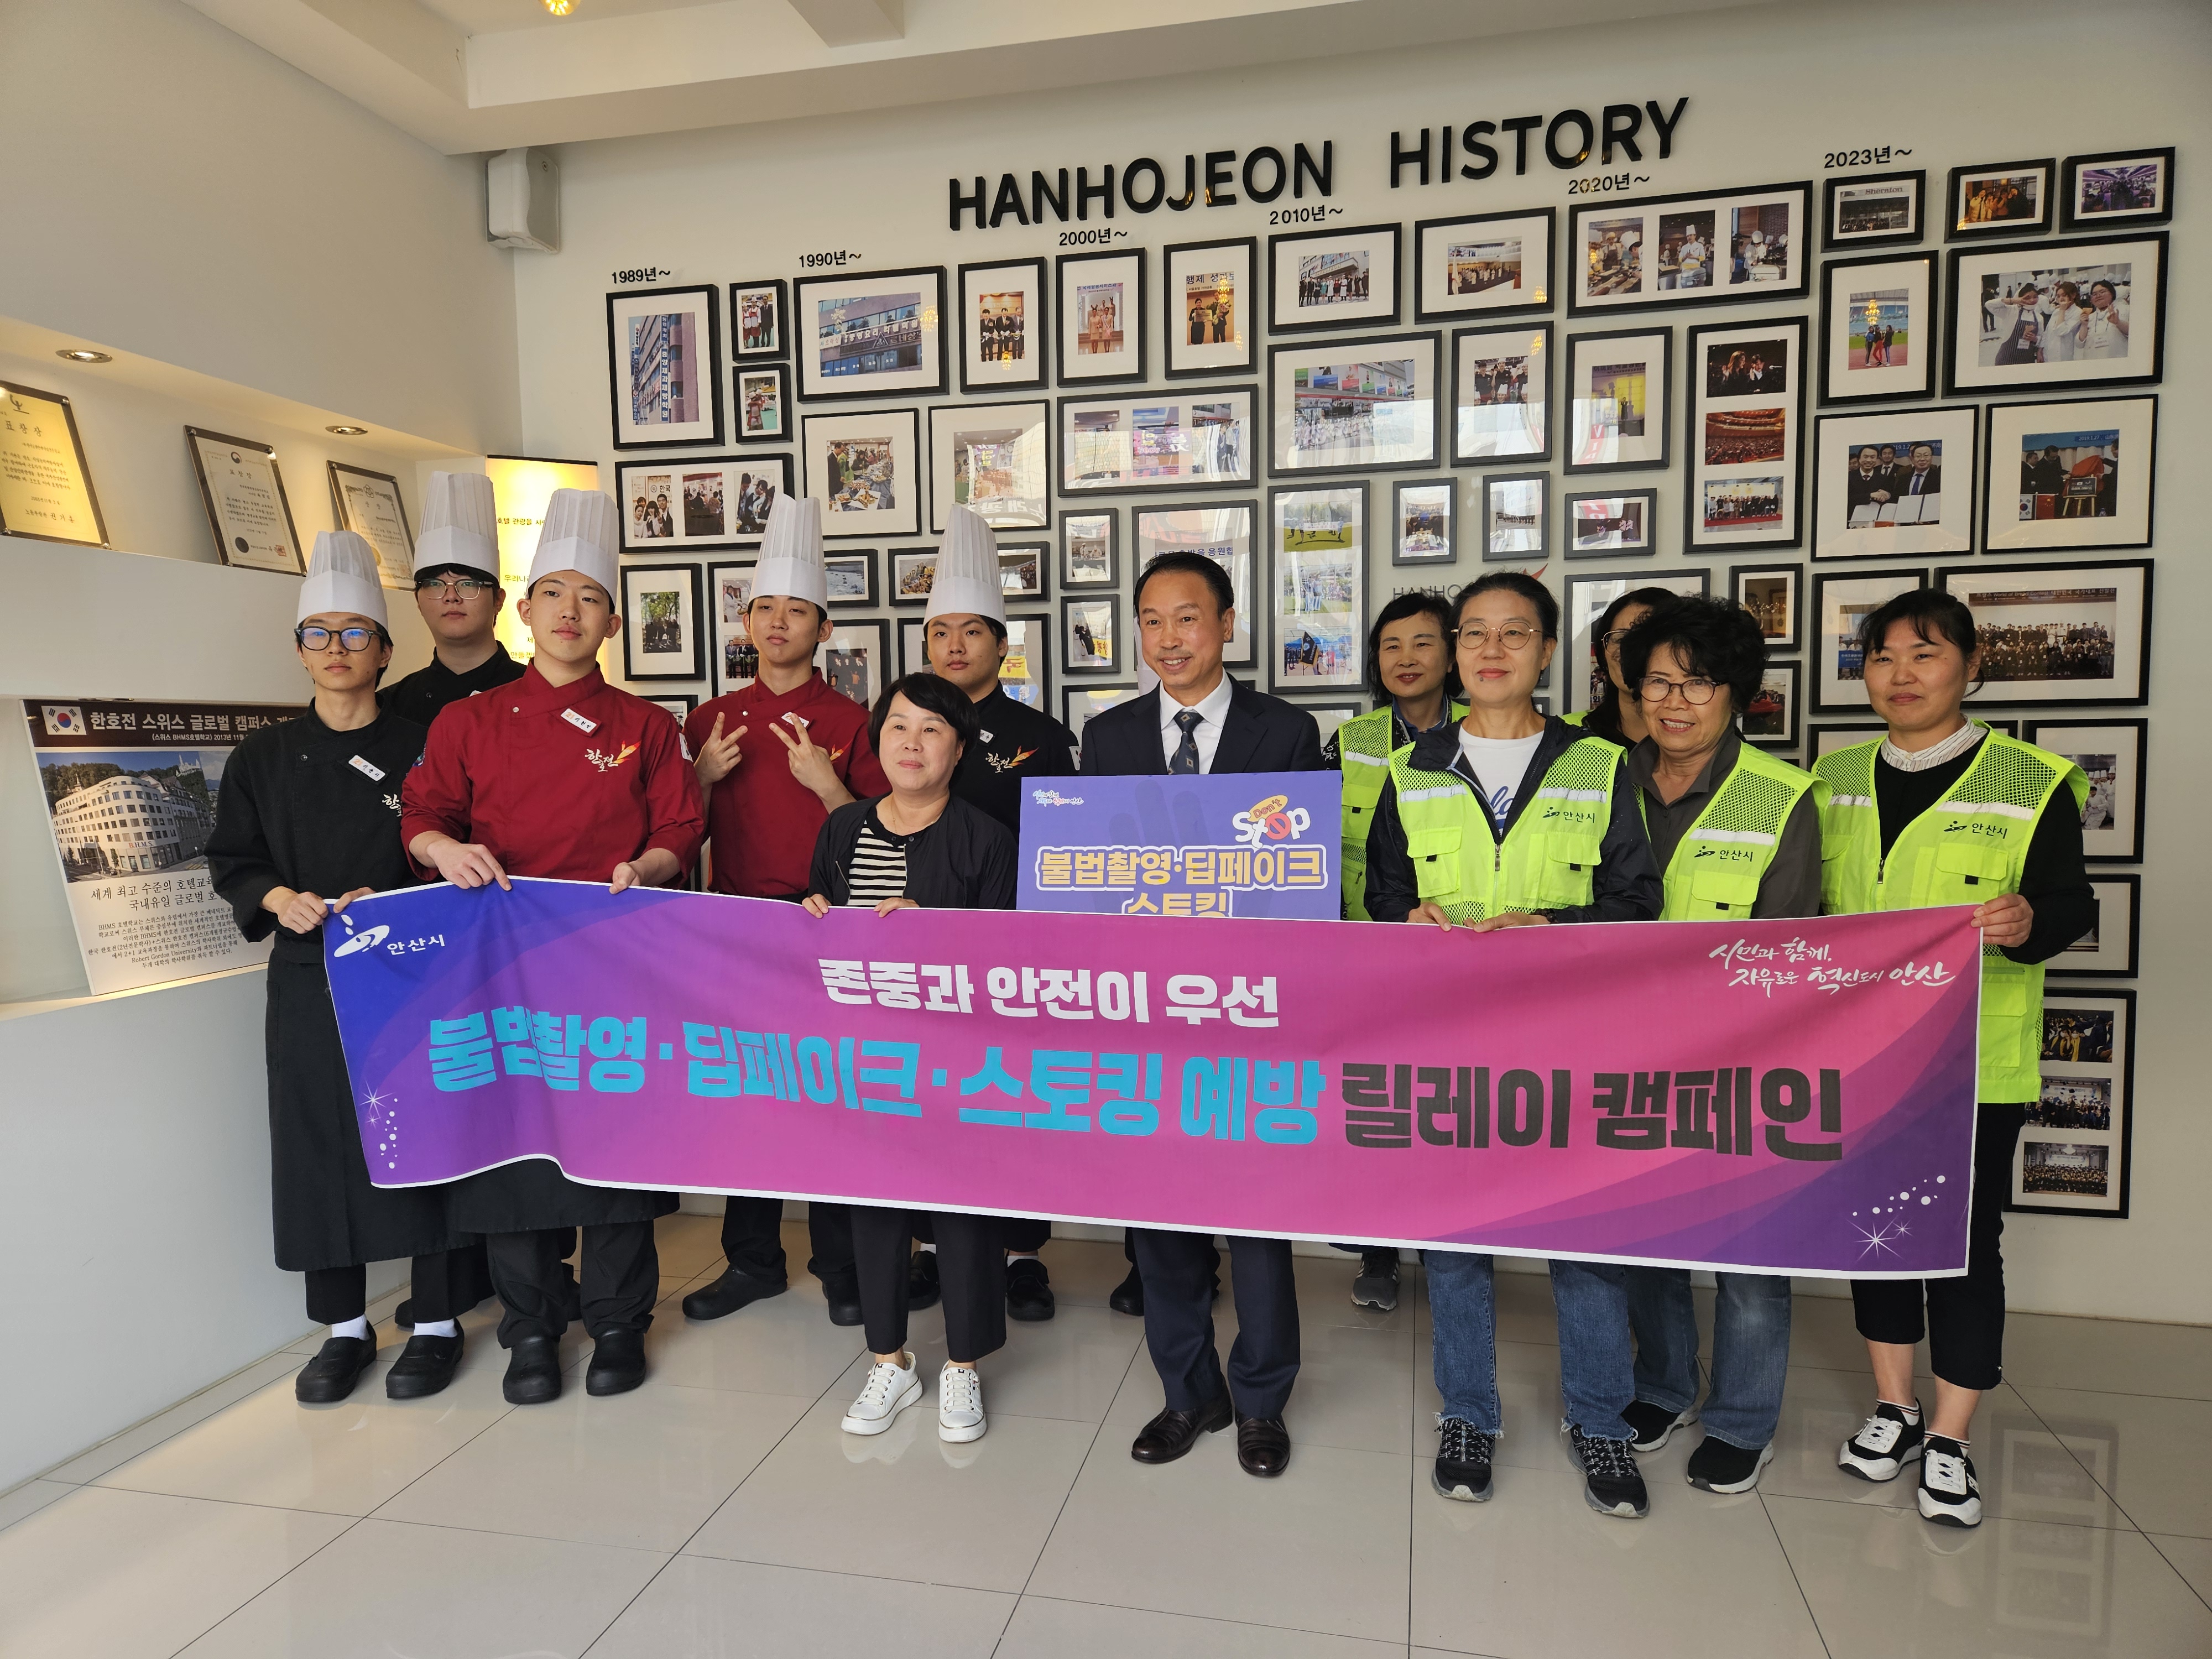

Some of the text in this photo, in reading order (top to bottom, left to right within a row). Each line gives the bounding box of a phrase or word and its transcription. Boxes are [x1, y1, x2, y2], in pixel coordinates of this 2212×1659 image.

[949, 96, 1691, 231] HANHOJEON HISTORY
[1824, 145, 1912, 169] 2023년~
[1568, 173, 1650, 195] 2020년~
[1865, 185, 1903, 195] Sheraton
[1270, 206, 1343, 225] 2010년~
[1059, 227, 1128, 246] 2000년~
[799, 250, 862, 268] 1990년~
[611, 267, 671, 284] 1989년~
[659, 484, 671, 493] 한국
[90, 711, 137, 731] 한호전
[142, 713, 185, 731] 스위스
[190, 714, 231, 732] 글로벌
[173, 733, 212, 742] BHMS호텔학교)
[1253, 797, 1282, 819] Don't
[1563, 811, 1595, 823] 안산시
[1971, 823, 2007, 839] 안산시
[1720, 849, 1754, 862] 안산시
[91, 887, 112, 901] 세계
[117, 885, 138, 898] 최고
[142, 880, 172, 895] 수준의
[129, 896, 171, 911] 국내유일
[175, 891, 204, 906] 글로벌
[140, 931, 161, 940] BHMS에
[387, 933, 446, 956] 안산시
[151, 952, 170, 960] Gordon
[171, 946, 202, 956] University와
[1709, 937, 1833, 970] 시민과 함께,
[1728, 961, 1957, 999] 자유로운 혁신도시 안산
[818, 958, 1280, 1028] 존중과 안전이 우선
[1180, 1055, 1327, 1145] 예방
[1342, 1063, 1571, 1150] 릴레이
[1592, 1066, 1843, 1162] 캠페인
